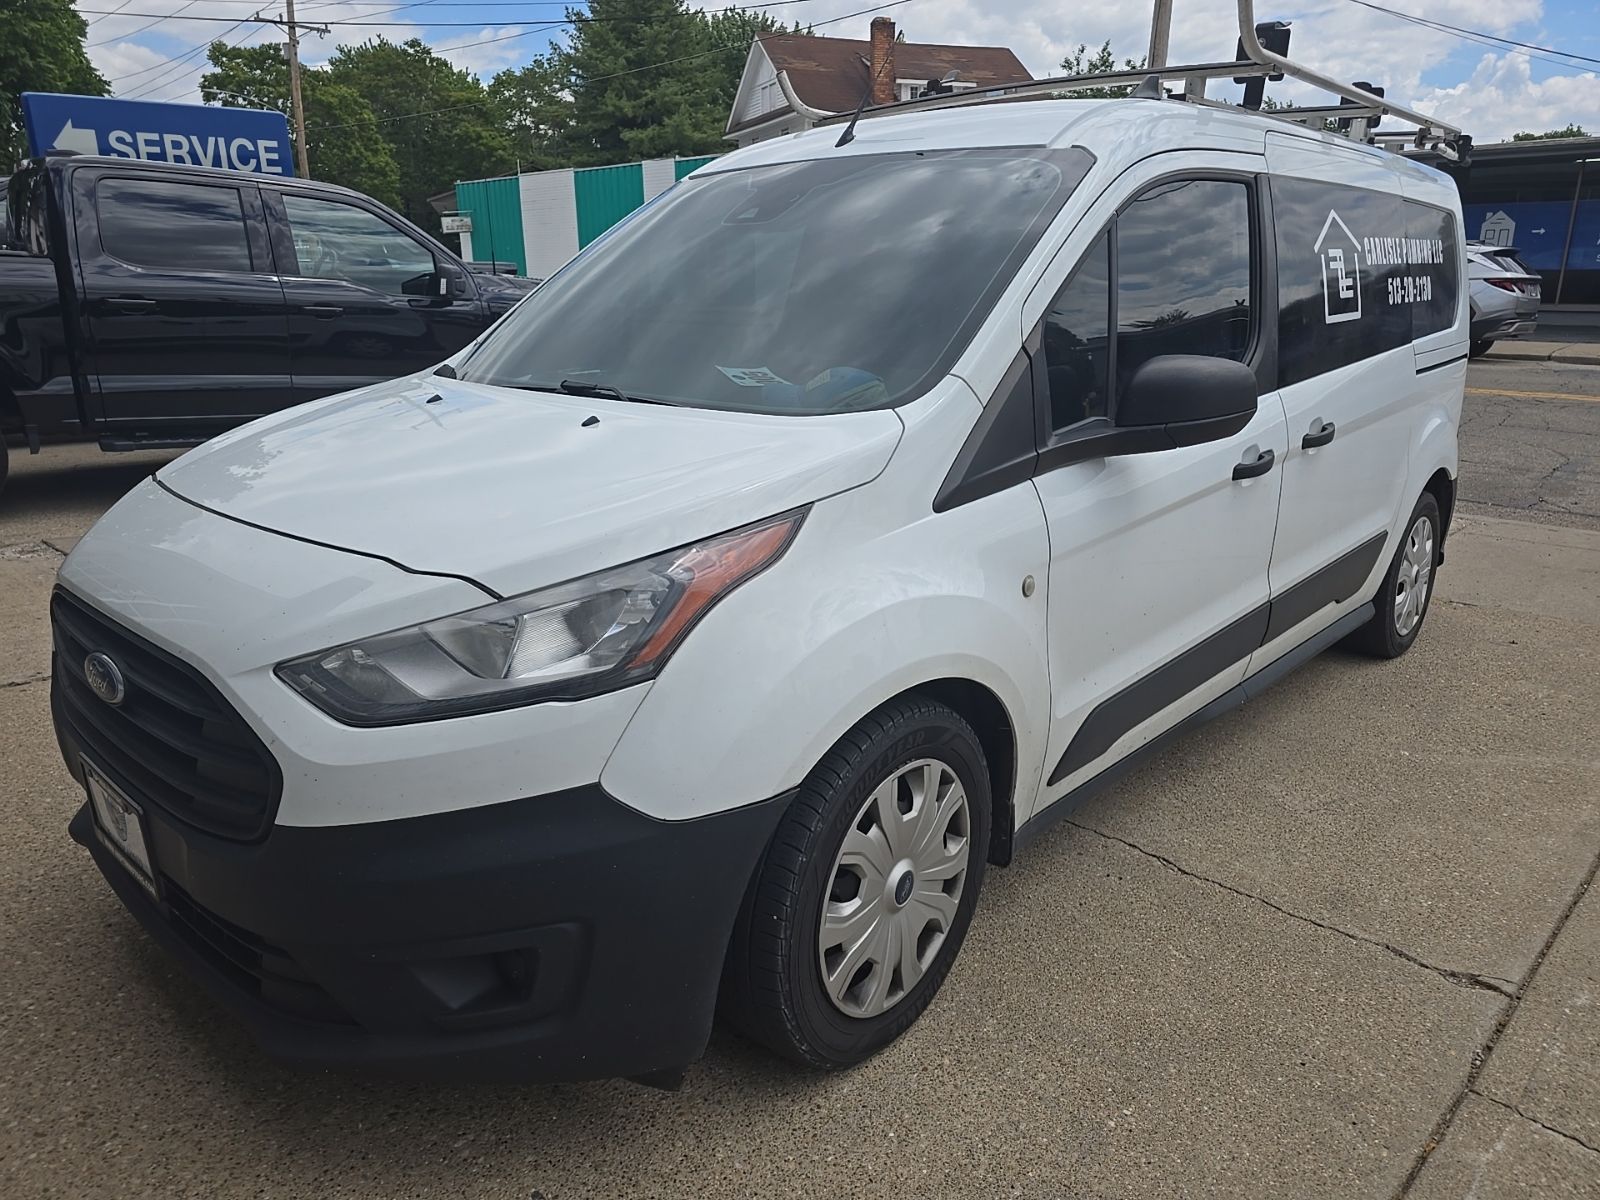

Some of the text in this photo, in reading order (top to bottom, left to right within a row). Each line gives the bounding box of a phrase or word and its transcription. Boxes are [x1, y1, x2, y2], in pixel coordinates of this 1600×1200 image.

[108, 129, 283, 173] SERVICE
[1364, 237, 1402, 265] CARLISLE
[1432, 239, 1444, 265] LLC
[88, 660, 110, 693] Ford
